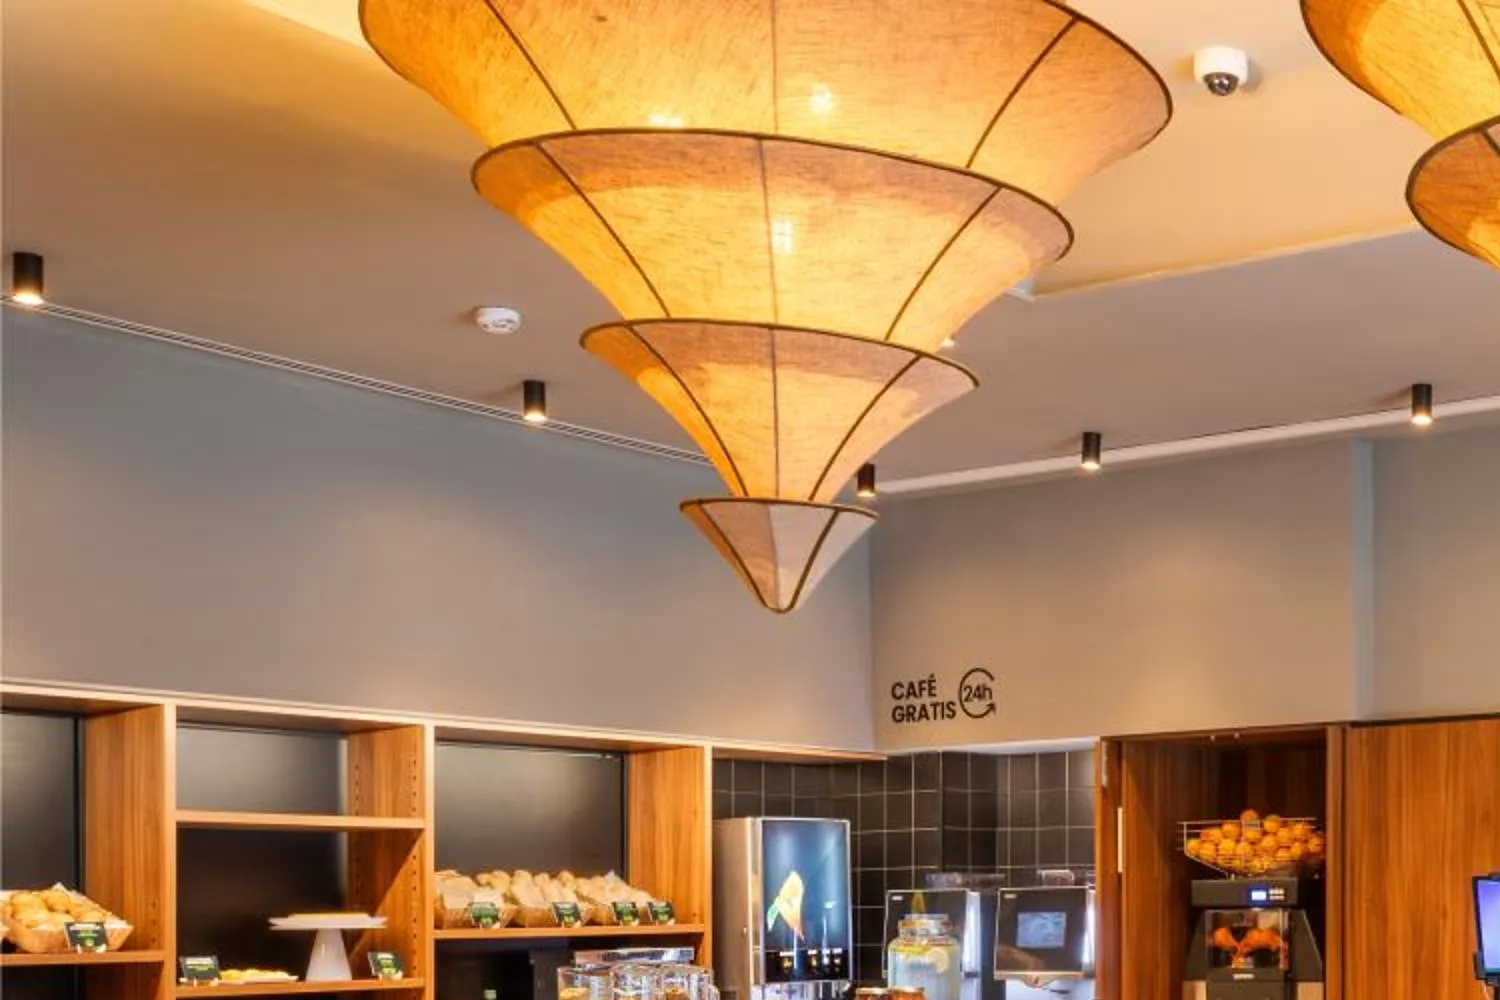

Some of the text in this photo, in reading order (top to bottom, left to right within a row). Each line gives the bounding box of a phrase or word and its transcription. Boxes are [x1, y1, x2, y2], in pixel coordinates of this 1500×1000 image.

[891, 672, 937, 701] CAFÉ
[963, 683, 993, 703] 24h
[891, 700, 957, 724] GRATIS
